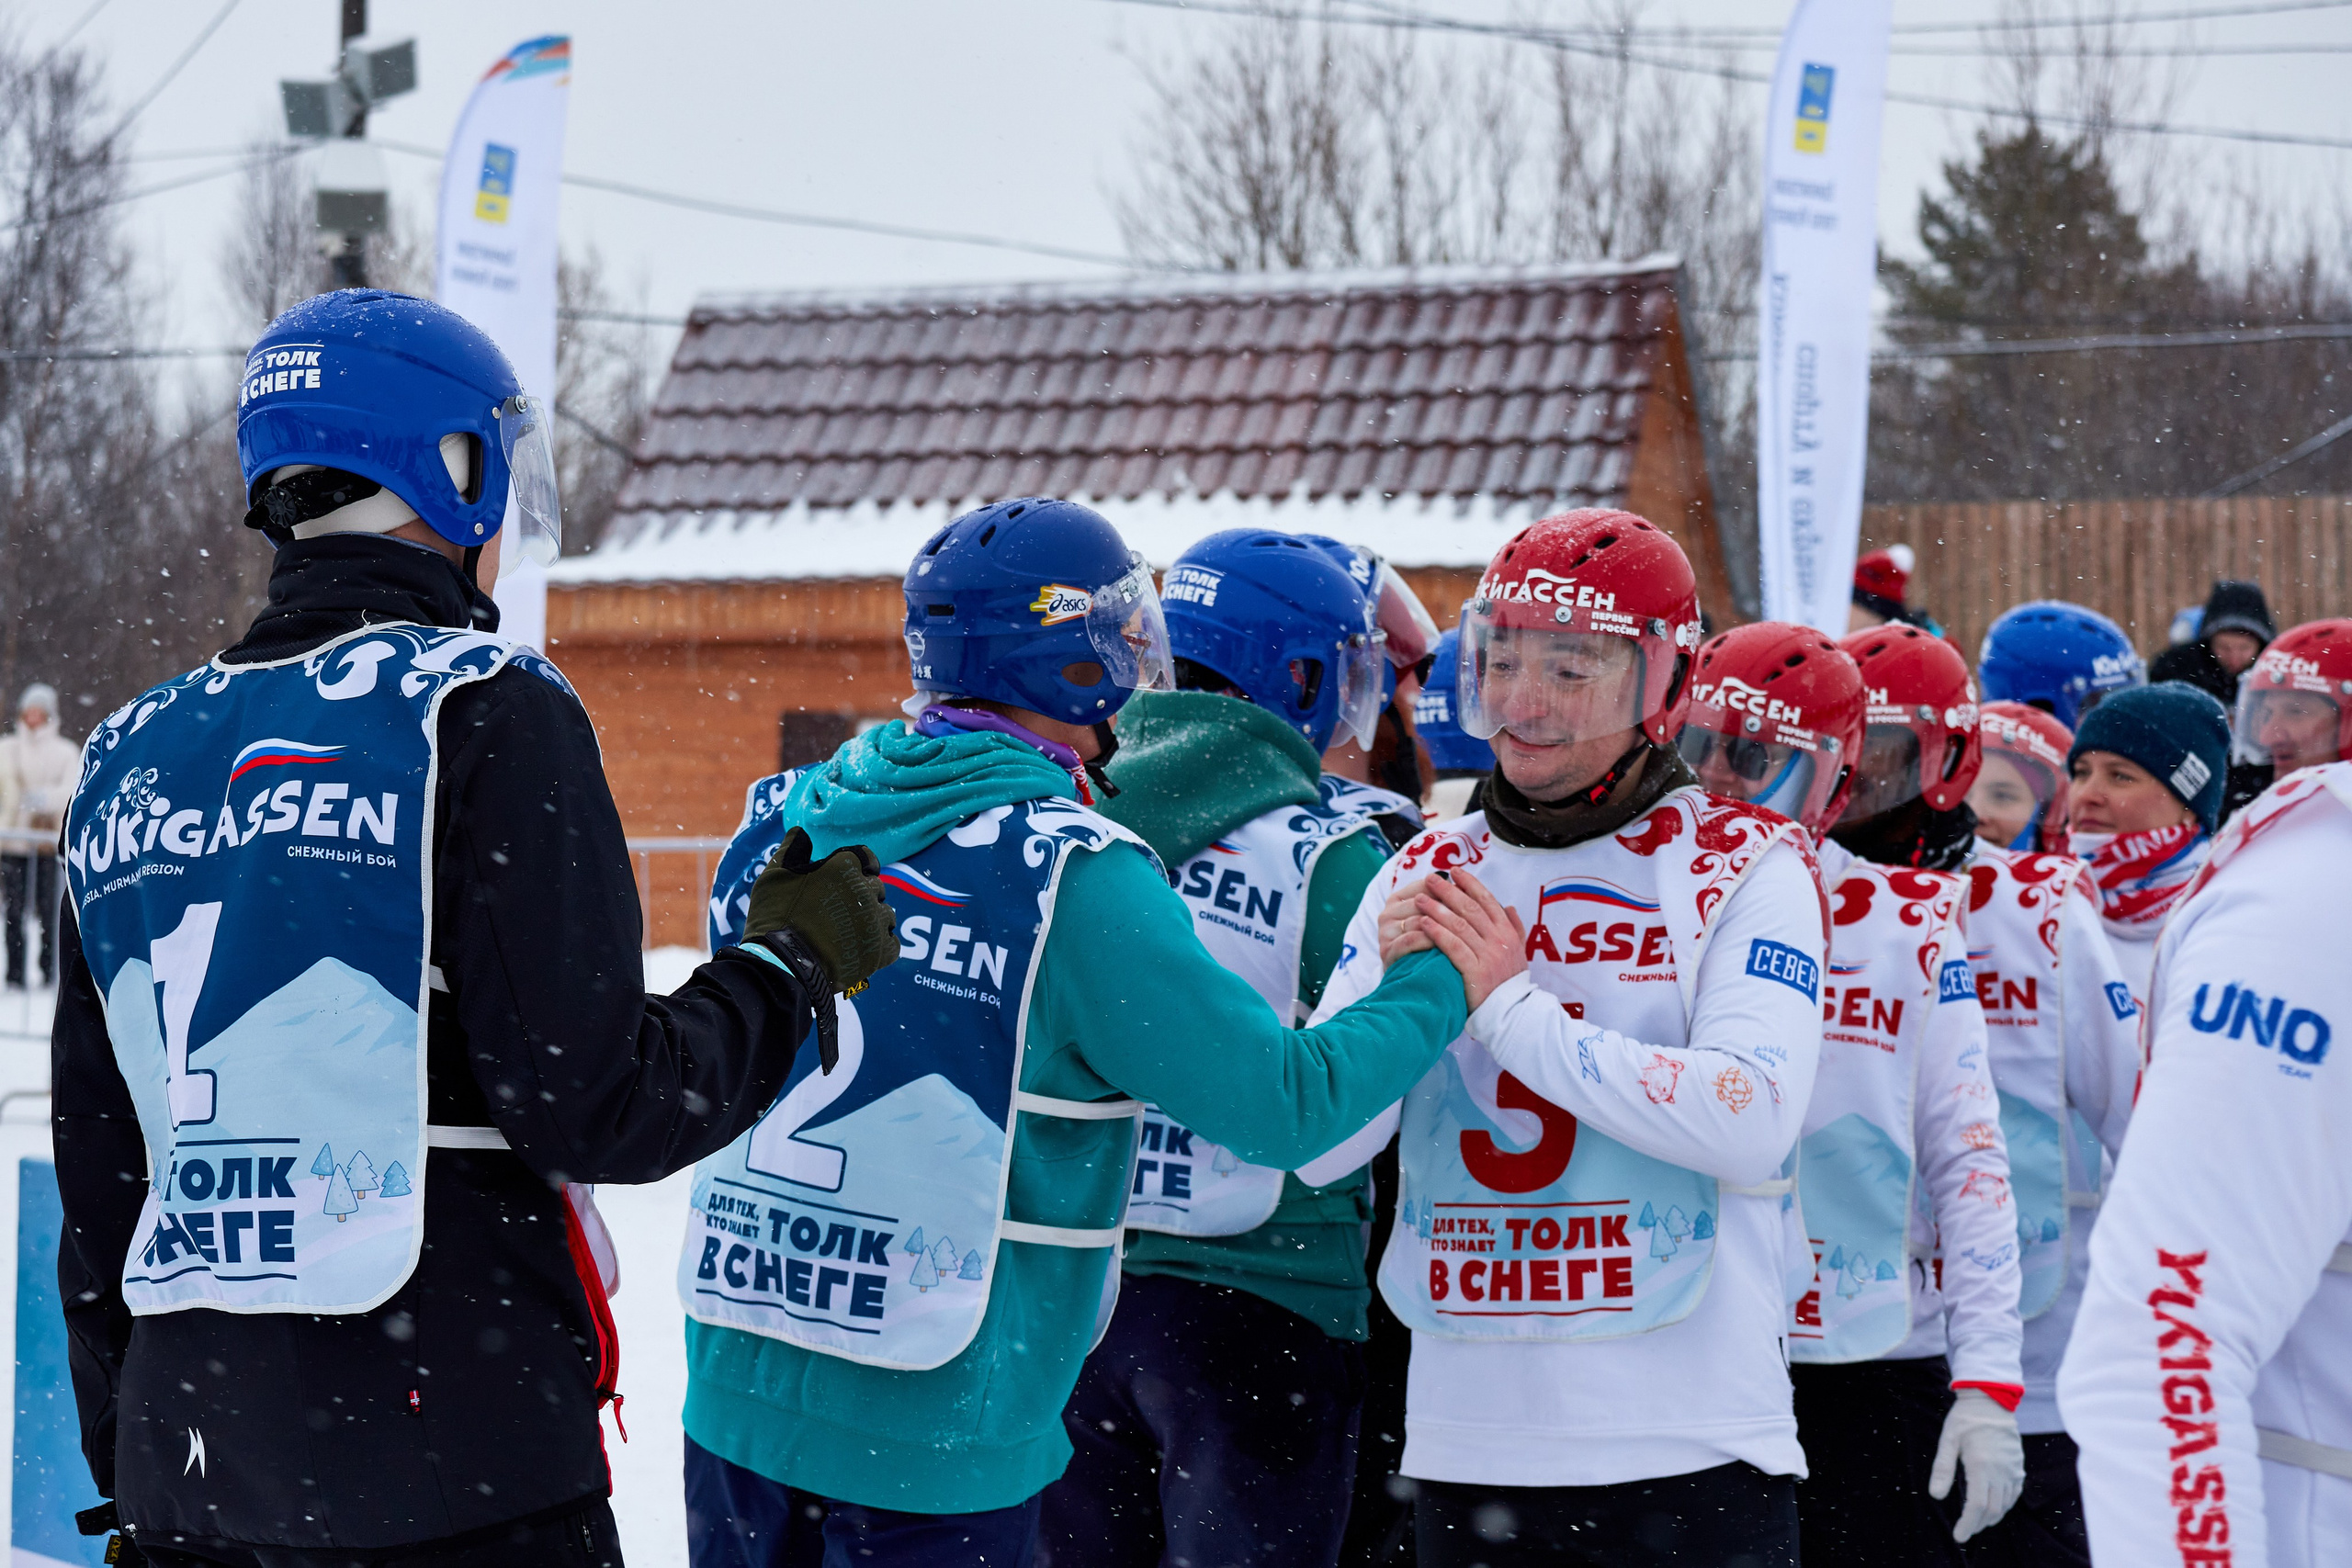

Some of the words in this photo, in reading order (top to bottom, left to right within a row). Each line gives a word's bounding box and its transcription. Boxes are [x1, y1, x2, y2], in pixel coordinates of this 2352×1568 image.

[266, 351, 322, 368] ТОЛК
[241, 386, 248, 408] В
[249, 368, 322, 400] СНЕГЕ
[1167, 583, 1217, 607] СНЕГЕ
[1182, 570, 1221, 591] ТОЛК
[1062, 597, 1087, 612] asics
[1591, 611, 1634, 626] ПЕРВЫЕ
[1590, 622, 1599, 631] В
[1600, 623, 1641, 637] РОССИИ
[141, 863, 185, 876] REGION
[287, 844, 362, 865] СНЕЖНЫЙ
[367, 852, 397, 867] БОЙ
[1198, 910, 1252, 937] СНЕЖНЫЙ
[1254, 931, 1275, 946] БОЙ
[1753, 944, 1817, 993] СЕВЕР
[914, 974, 978, 1000] СНЕЖНЫЙ
[979, 992, 1001, 1010] БОЙ
[150, 900, 222, 1134] 1
[2189, 981, 2332, 1066] UNO
[746, 992, 865, 1192] 2
[707, 1192, 735, 1213] ДЛЯ
[736, 1200, 760, 1223] ТЕХ,
[707, 1213, 728, 1230] КТО
[728, 1219, 761, 1239] ЗНАЕТ
[767, 1208, 895, 1267] ТОЛК
[1432, 1218, 1454, 1235] ДЛЯ
[1457, 1217, 1495, 1235] ТЕХ,
[1505, 1214, 1632, 1251] ТОЛК
[1451, 1240, 1496, 1252] ЗНАЕТ
[697, 1235, 722, 1280] В
[723, 1243, 888, 1320] СНЕГЕ
[1430, 1258, 1450, 1302] В
[1459, 1256, 1634, 1303] СНЕГЕ
